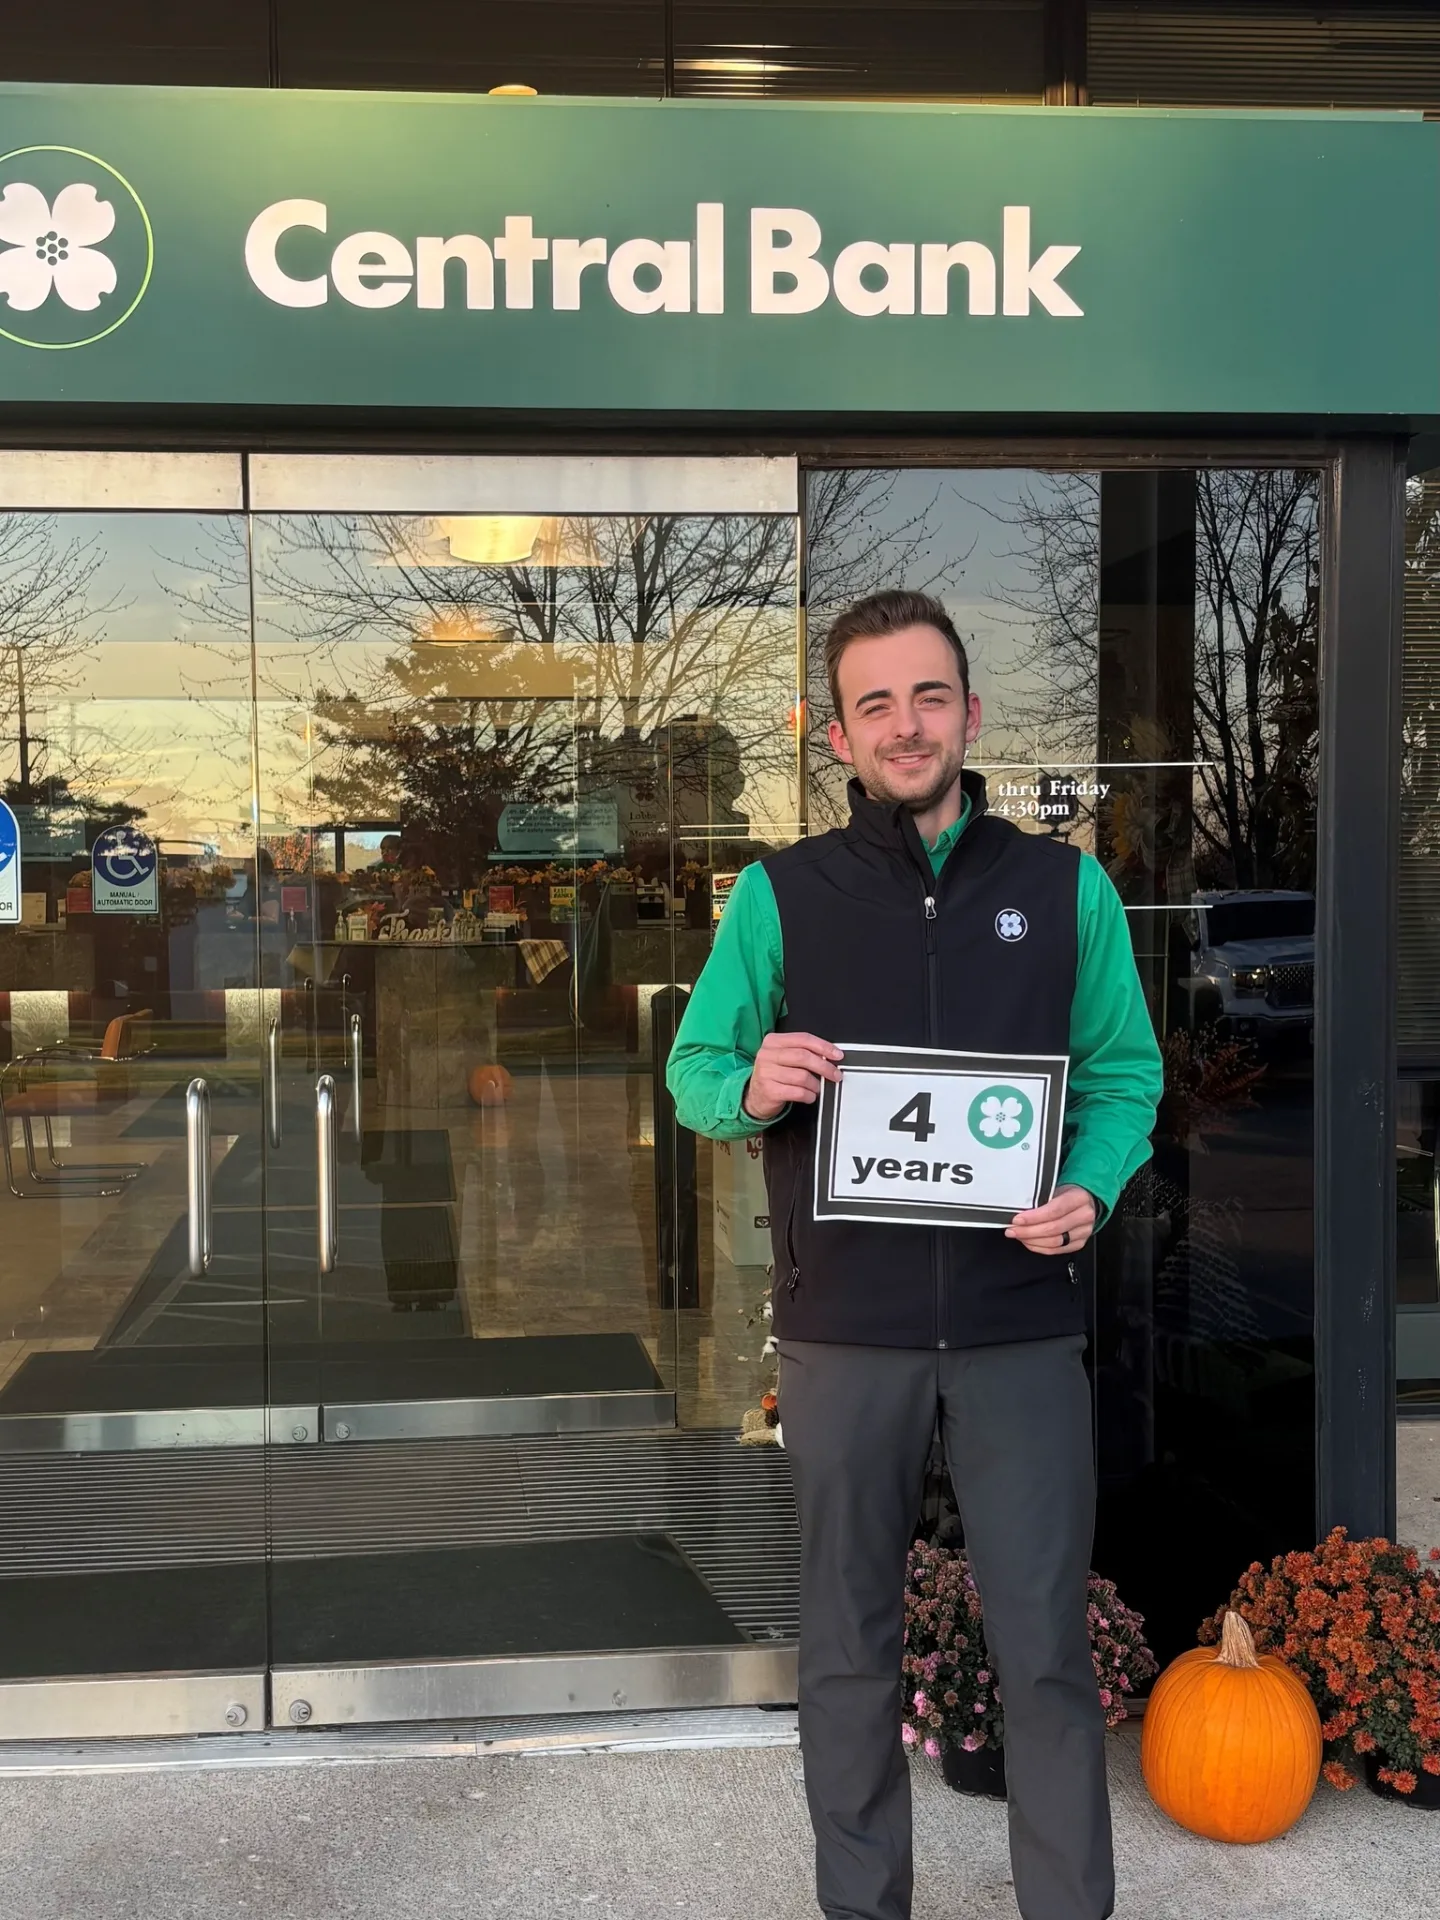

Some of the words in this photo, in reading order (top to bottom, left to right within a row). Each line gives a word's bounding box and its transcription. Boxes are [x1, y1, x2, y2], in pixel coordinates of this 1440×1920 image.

[245, 199, 724, 315] Central
[751, 207, 1084, 317] Bank
[998, 781, 1041, 797] thru
[1050, 780, 1111, 799] Friday
[889, 1091, 936, 1143] 4
[851, 1155, 974, 1185] years
